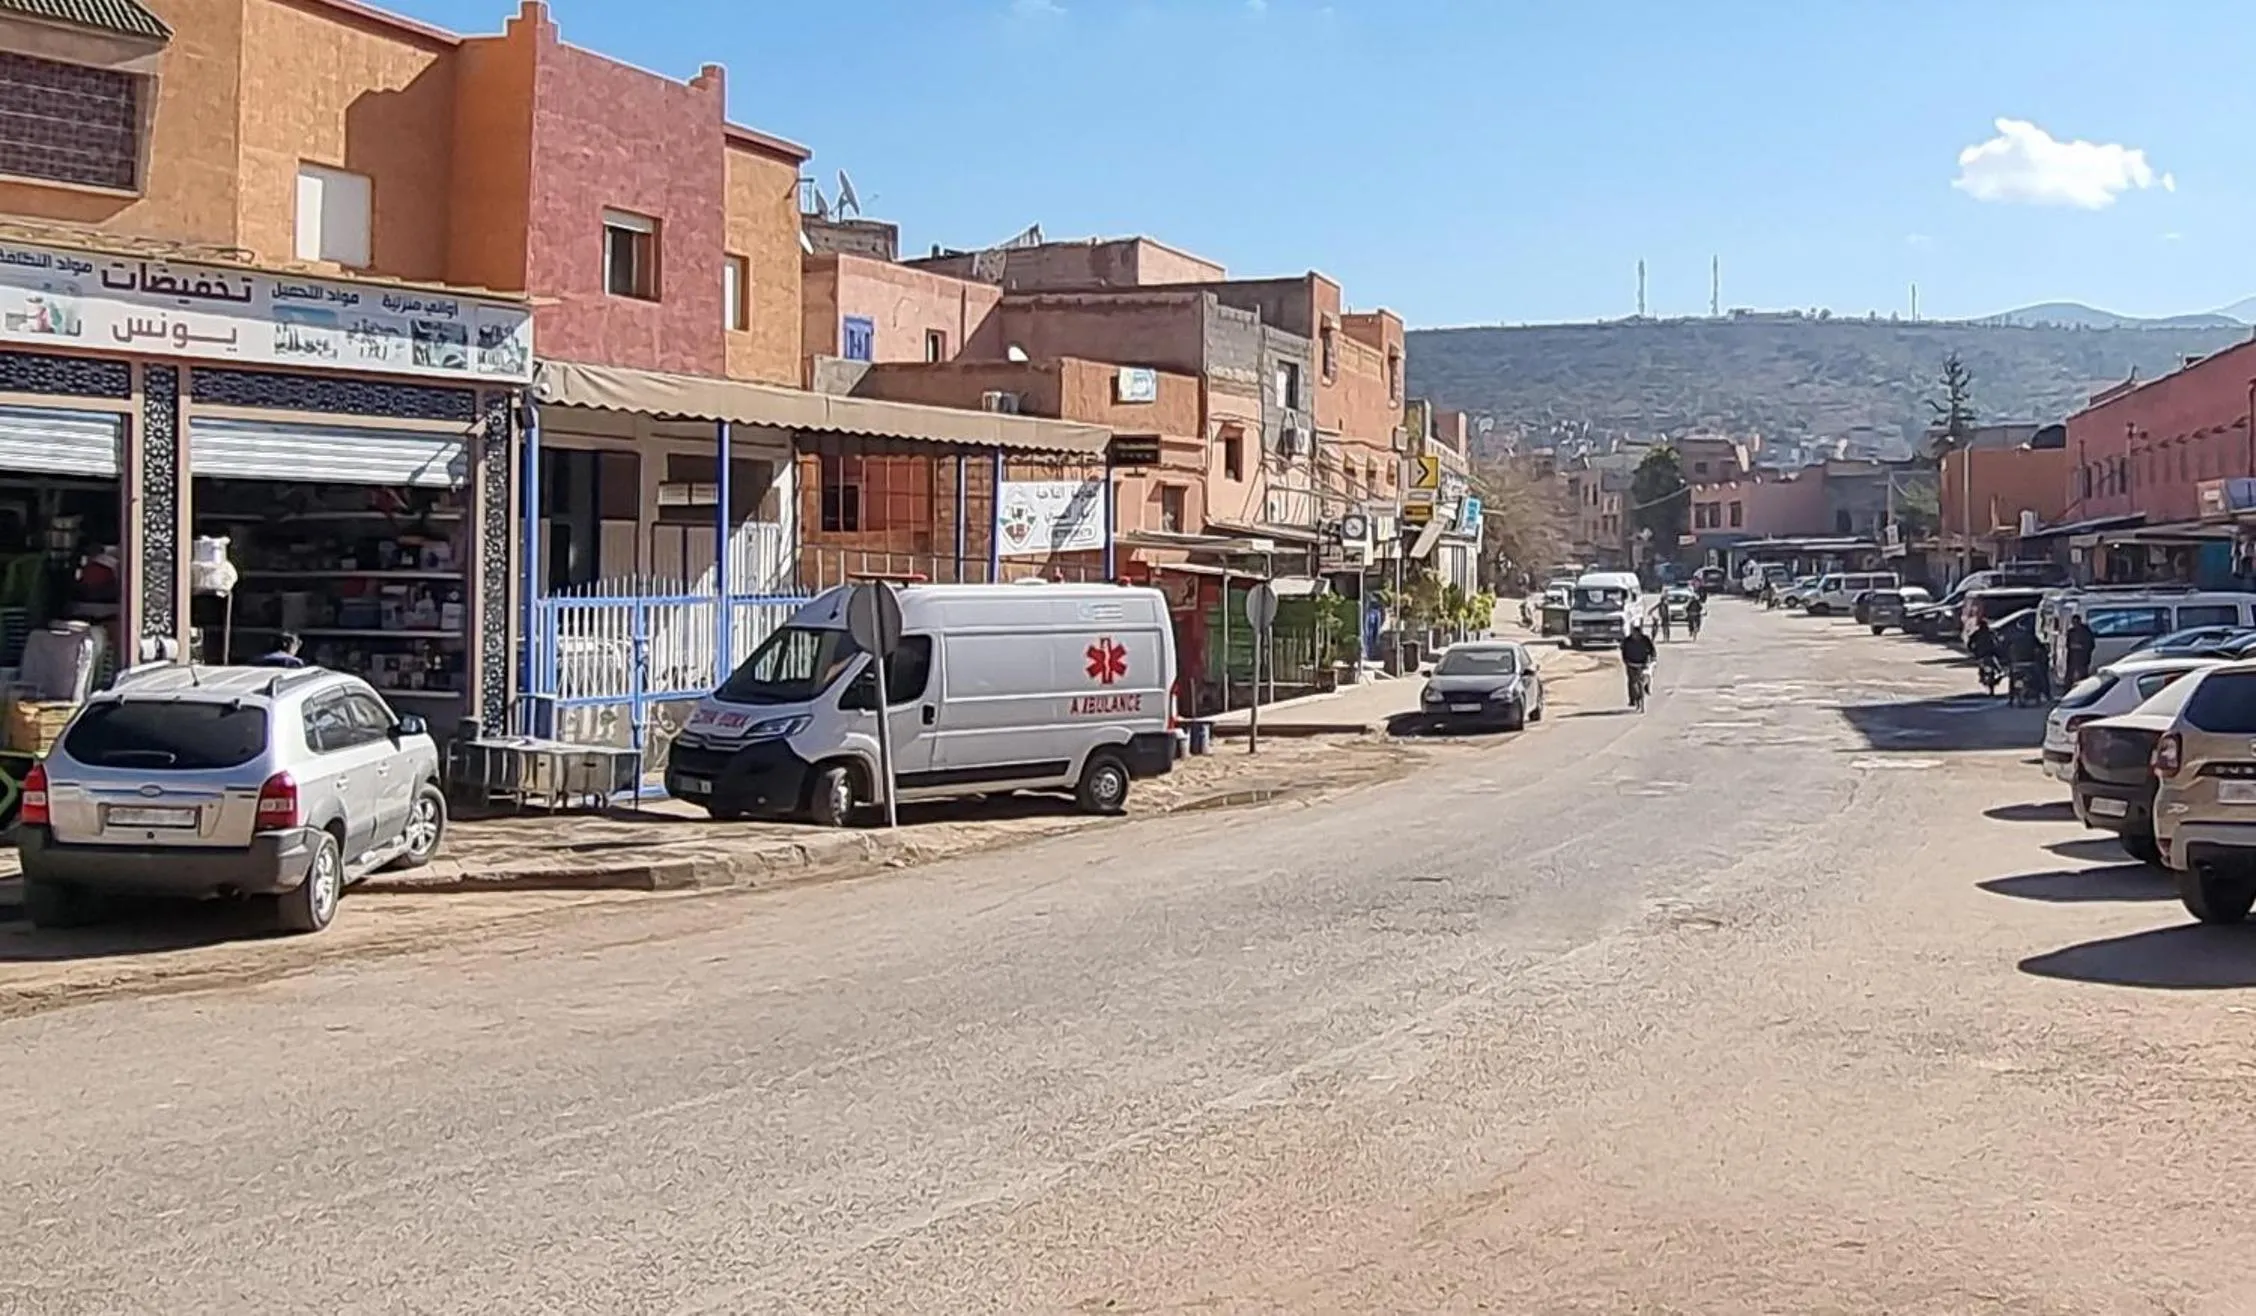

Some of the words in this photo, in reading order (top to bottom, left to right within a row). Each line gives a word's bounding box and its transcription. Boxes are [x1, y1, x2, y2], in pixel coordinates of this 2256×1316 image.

[56, 256, 92, 276] مواد
[101, 262, 253, 304] تخفيضات
[327, 287, 359, 307] مواد
[112, 312, 237, 352] يونس
